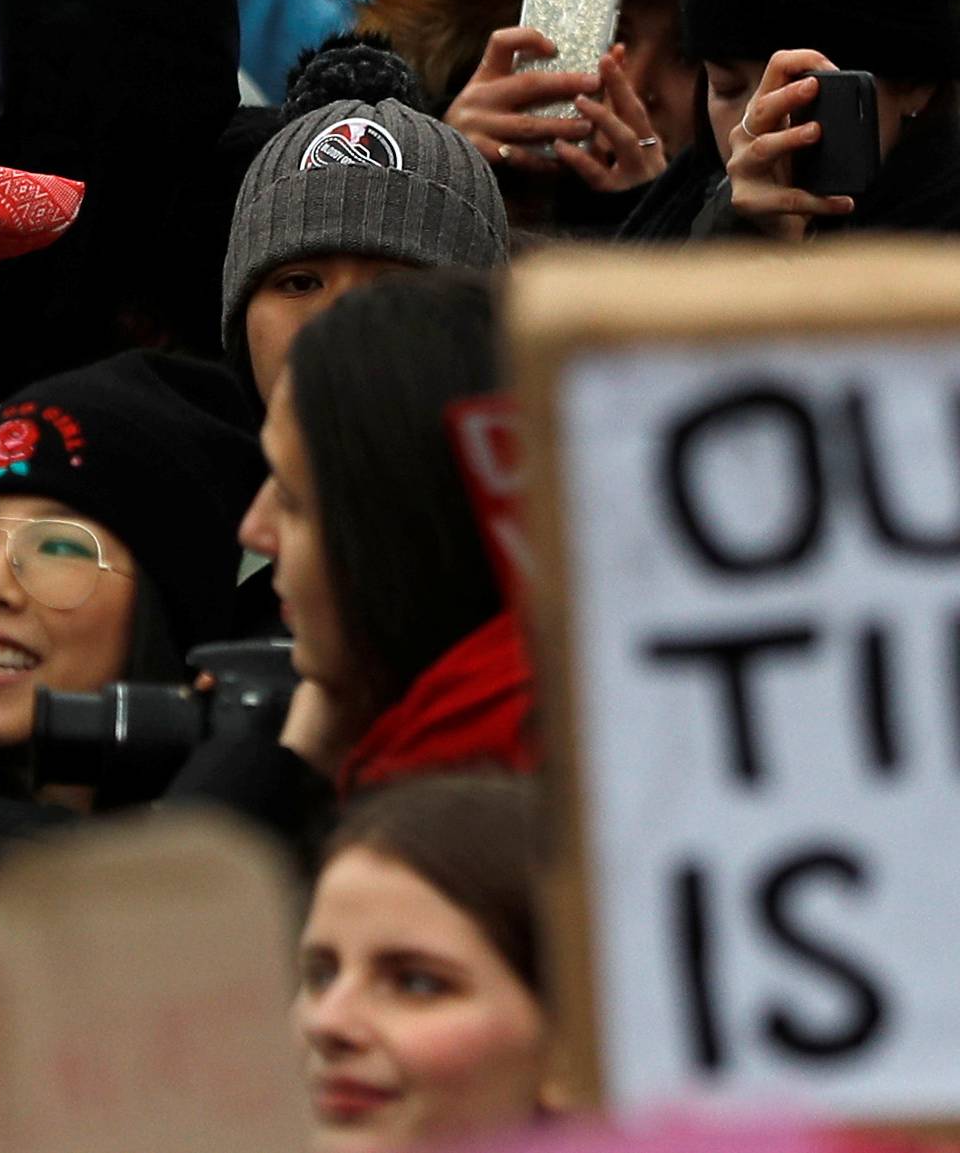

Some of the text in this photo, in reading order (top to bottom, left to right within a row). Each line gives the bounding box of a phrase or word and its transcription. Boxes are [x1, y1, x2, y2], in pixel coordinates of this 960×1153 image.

[658, 378, 960, 583] OU
[642, 620, 960, 790] TI
[672, 850, 890, 1078] IS
